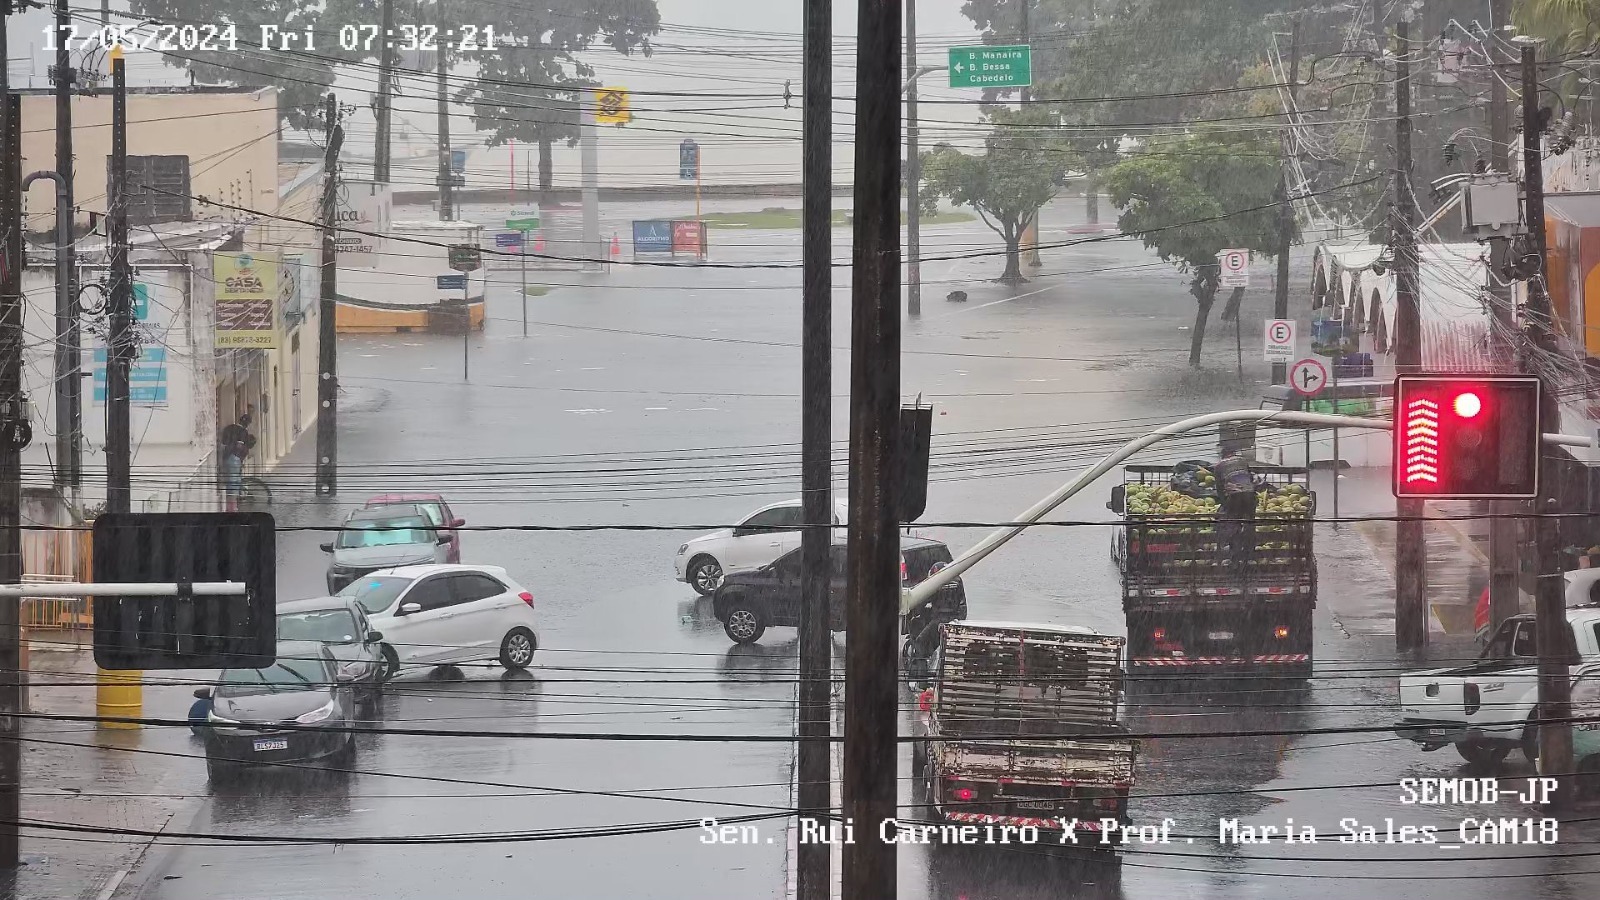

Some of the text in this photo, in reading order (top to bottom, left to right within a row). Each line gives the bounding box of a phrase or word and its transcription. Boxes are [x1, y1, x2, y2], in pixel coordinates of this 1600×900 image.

[969, 63, 1010, 71] B. Bessa
[969, 74, 1014, 82] Cabedelo
[1231, 256, 1239, 266] E
[225, 276, 263, 288] CASA
[1276, 327, 1285, 339] E
